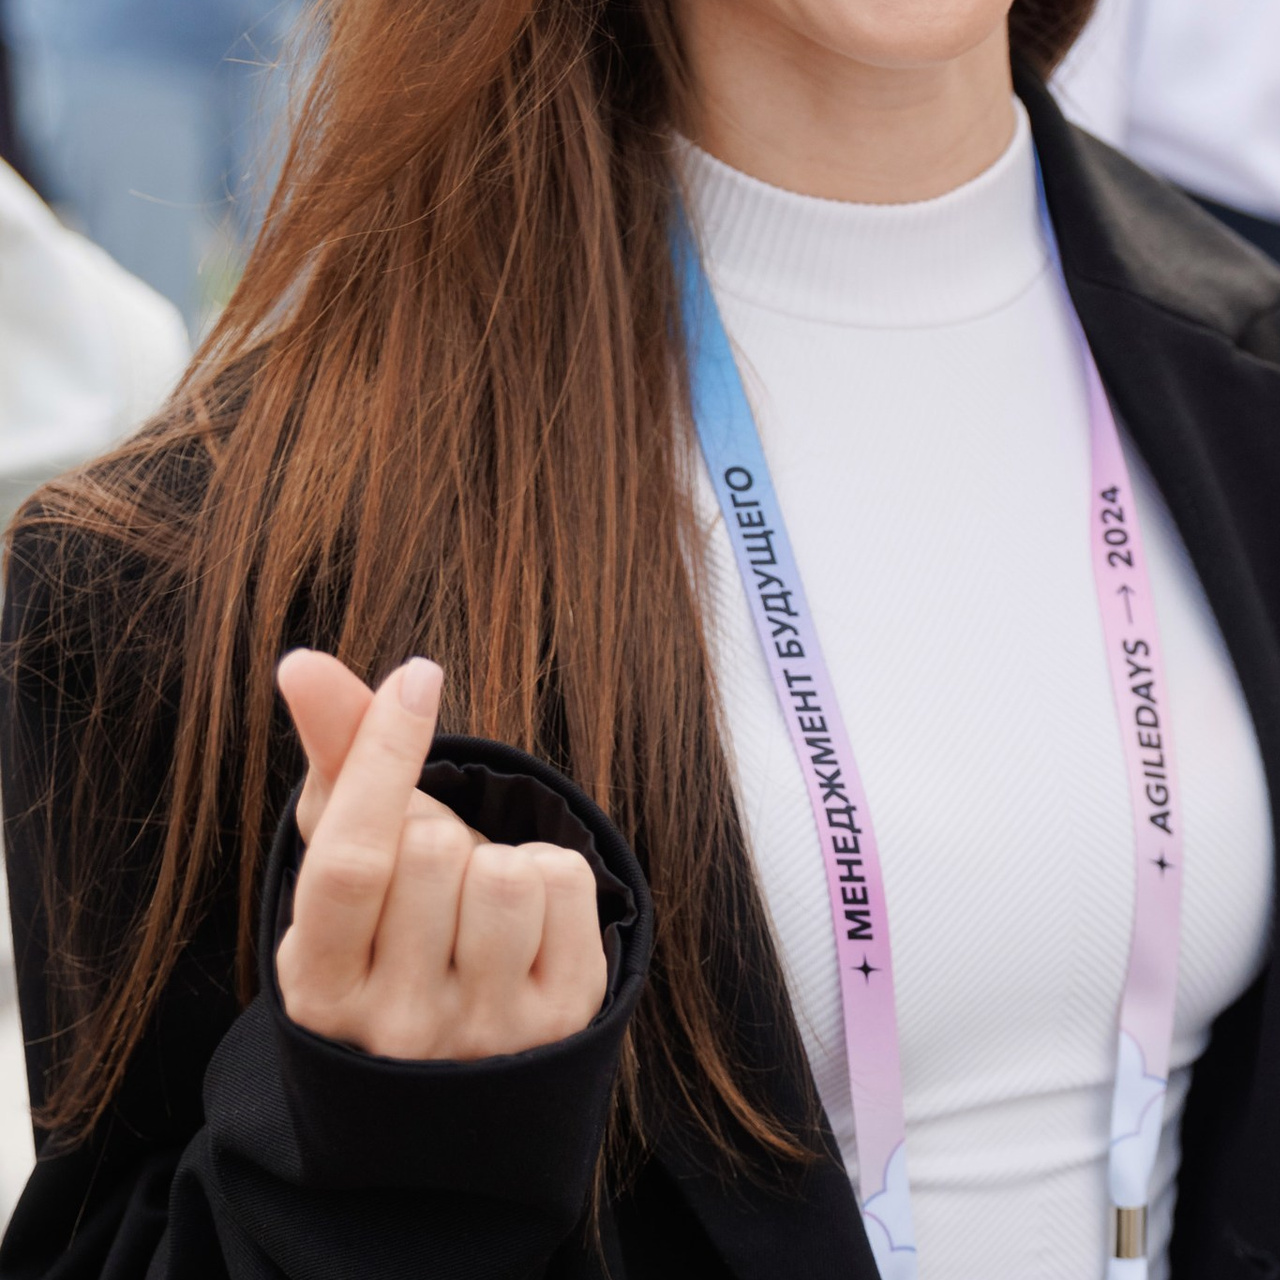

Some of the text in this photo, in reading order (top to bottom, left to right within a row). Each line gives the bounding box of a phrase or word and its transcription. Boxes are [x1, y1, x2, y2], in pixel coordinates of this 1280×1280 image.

[724, 465, 874, 941] МЕНЕДЖМЕНТ БУДУЩЕГО
[1101, 484, 1174, 835] AGILEDAYS 2024
